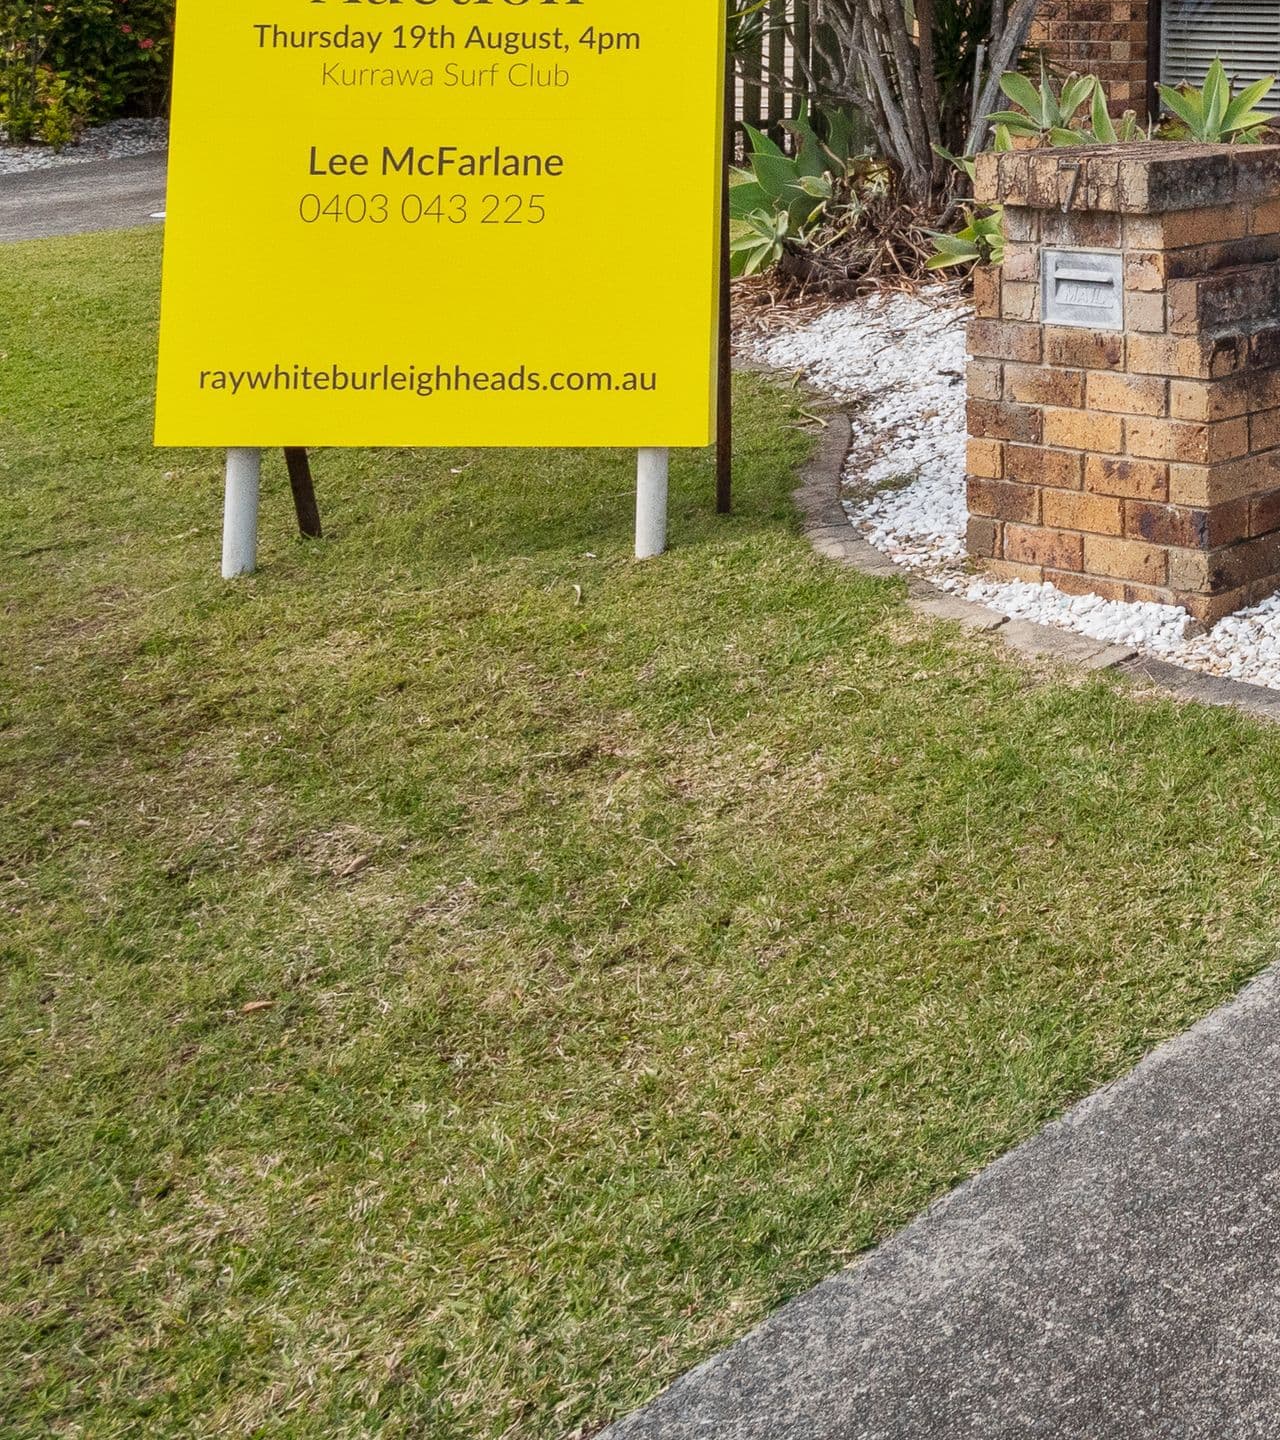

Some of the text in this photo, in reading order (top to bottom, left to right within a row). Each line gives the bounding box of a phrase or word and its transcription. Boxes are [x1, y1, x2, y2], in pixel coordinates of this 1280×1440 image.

[253, 23, 640, 55] Thursday 19th August, 4pm
[322, 62, 570, 87] Kurrawa Surf Club
[309, 145, 564, 177] Lee McFarlane
[298, 193, 546, 224] 0403 043 225
[1064, 286, 1106, 305] MAIL
[199, 363, 657, 397] raywhiteburleighheads.com.au
